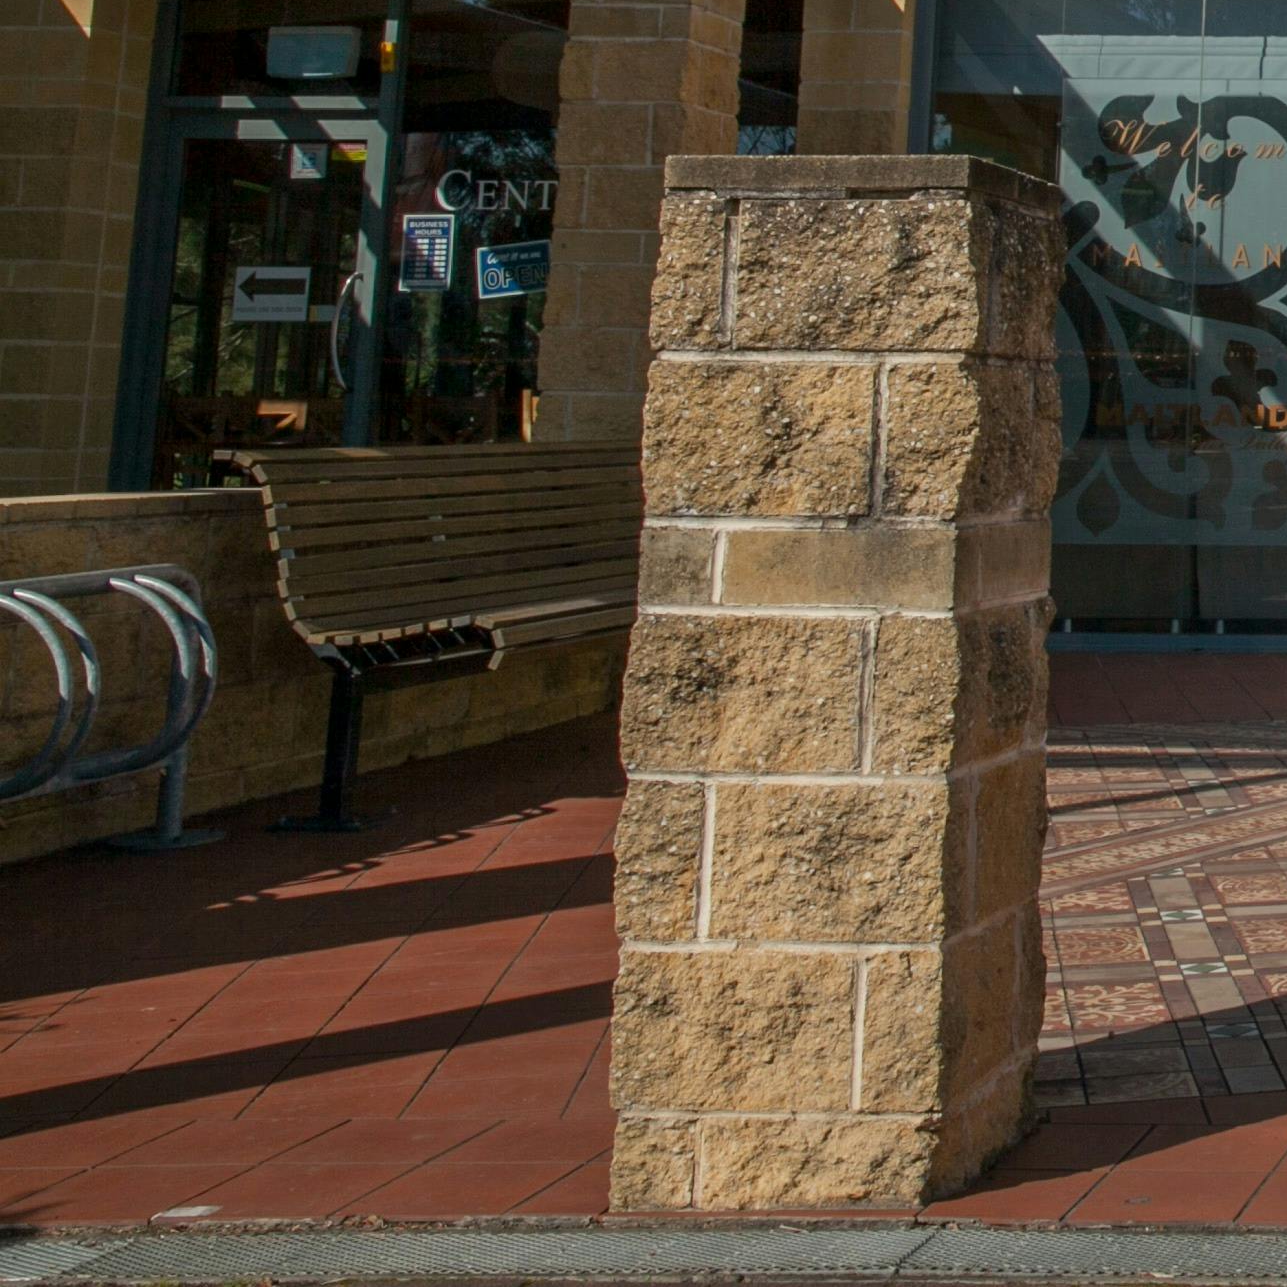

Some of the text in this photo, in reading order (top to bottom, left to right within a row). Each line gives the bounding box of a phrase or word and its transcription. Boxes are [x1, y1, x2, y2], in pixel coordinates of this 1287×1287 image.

[435, 169, 559, 211] CENT
[1186, 183, 1224, 211] to
[409, 221, 449, 229] BUSINESS
[414, 229, 443, 237] HOURS
[484, 263, 549, 290] OPEN
